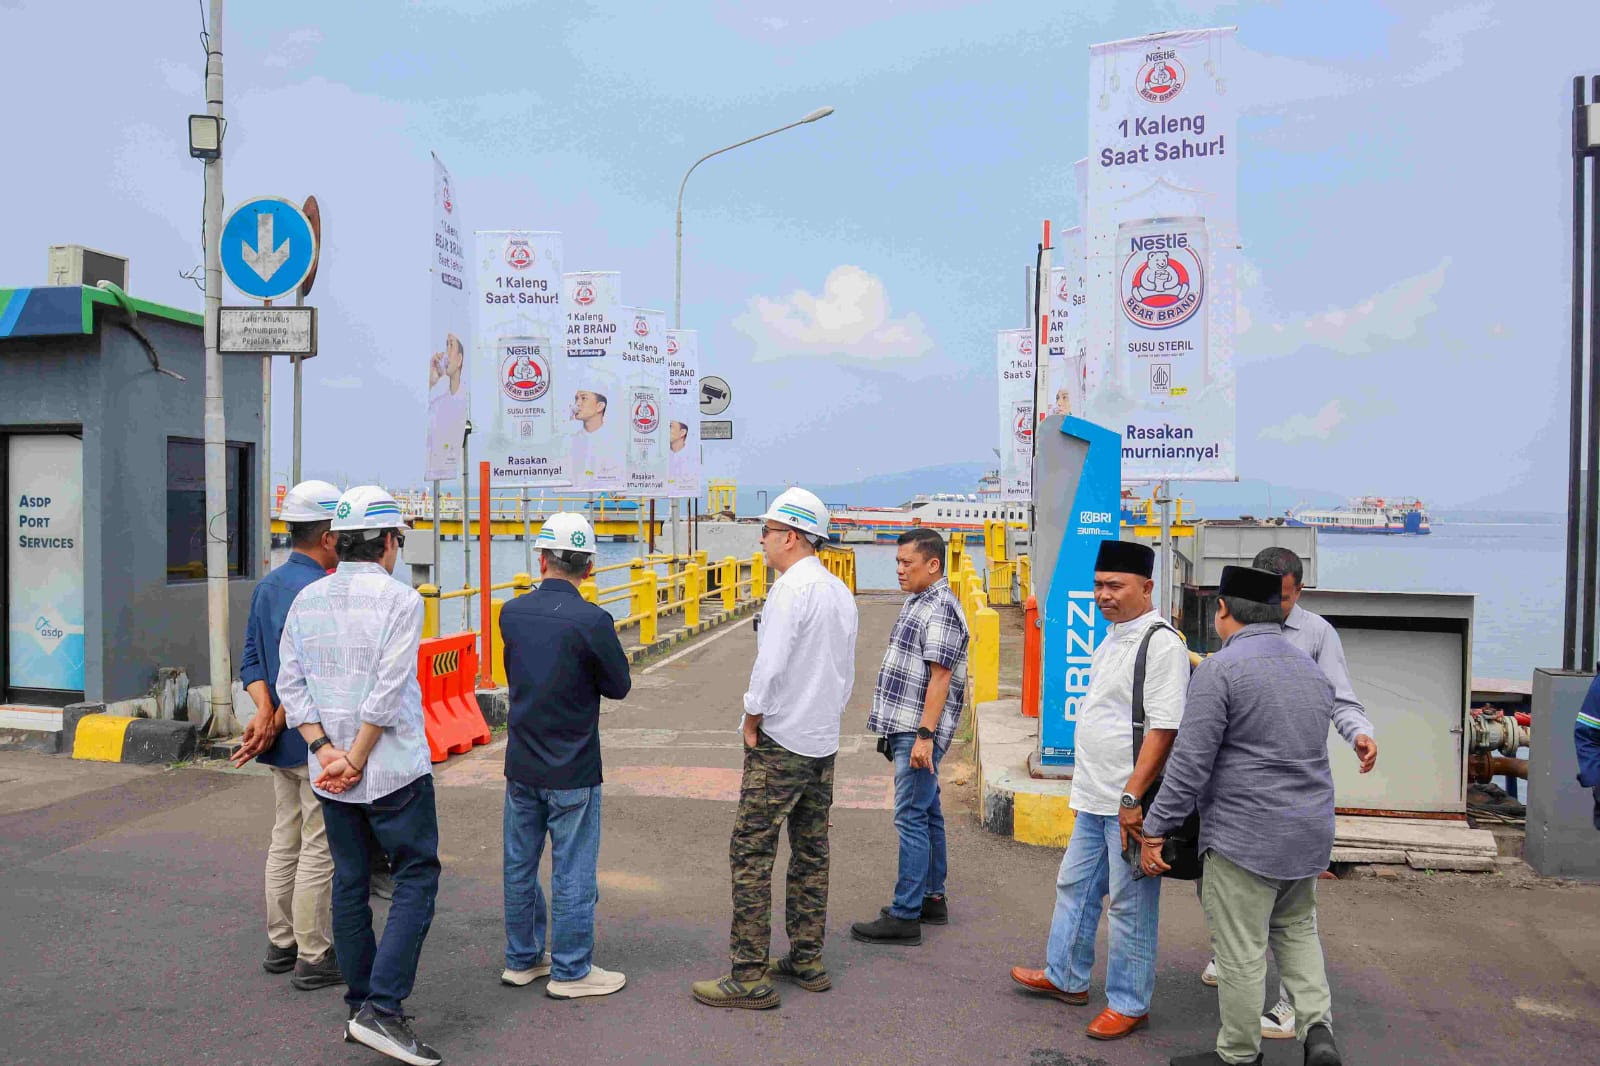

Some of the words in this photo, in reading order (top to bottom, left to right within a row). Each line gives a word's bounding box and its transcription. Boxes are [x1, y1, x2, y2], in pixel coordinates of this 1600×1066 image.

[1140, 88, 1157, 101] BEAR
[1159, 83, 1181, 101] BRAND
[1119, 120, 1128, 138] 1
[1136, 115, 1205, 135] Kaleng
[1101, 144, 1149, 167] Saat
[1155, 135, 1224, 161] Sahur!
[496, 277, 502, 288] 1
[506, 277, 548, 291] Kaleng
[486, 293, 515, 304] Saat
[519, 292, 558, 304] Sahur!
[1126, 298, 1153, 320] BEAR
[1158, 294, 1196, 320] BRAND
[574, 313, 603, 322] Kaleng
[244, 326, 287, 335] Penumpang
[584, 324, 616, 334] BRAND
[583, 336, 612, 344] Sahur!
[1128, 342, 1155, 352] SUSU
[1158, 340, 1194, 351] STERIL
[628, 342, 632, 350] 1
[634, 342, 658, 354] Kaleng
[622, 352, 640, 362] Saat
[641, 355, 664, 364] Sahur!
[1010, 360, 1015, 368] 1
[1004, 371, 1024, 379] Saat
[506, 380, 522, 395] BEAR
[524, 381, 546, 396] BRAND
[1126, 424, 1193, 440] Rasakan
[508, 456, 547, 465] Rasakan
[494, 466, 562, 477] Kemurniannya!
[1092, 512, 1112, 523] BRI
[42, 628, 63, 638] asdp
